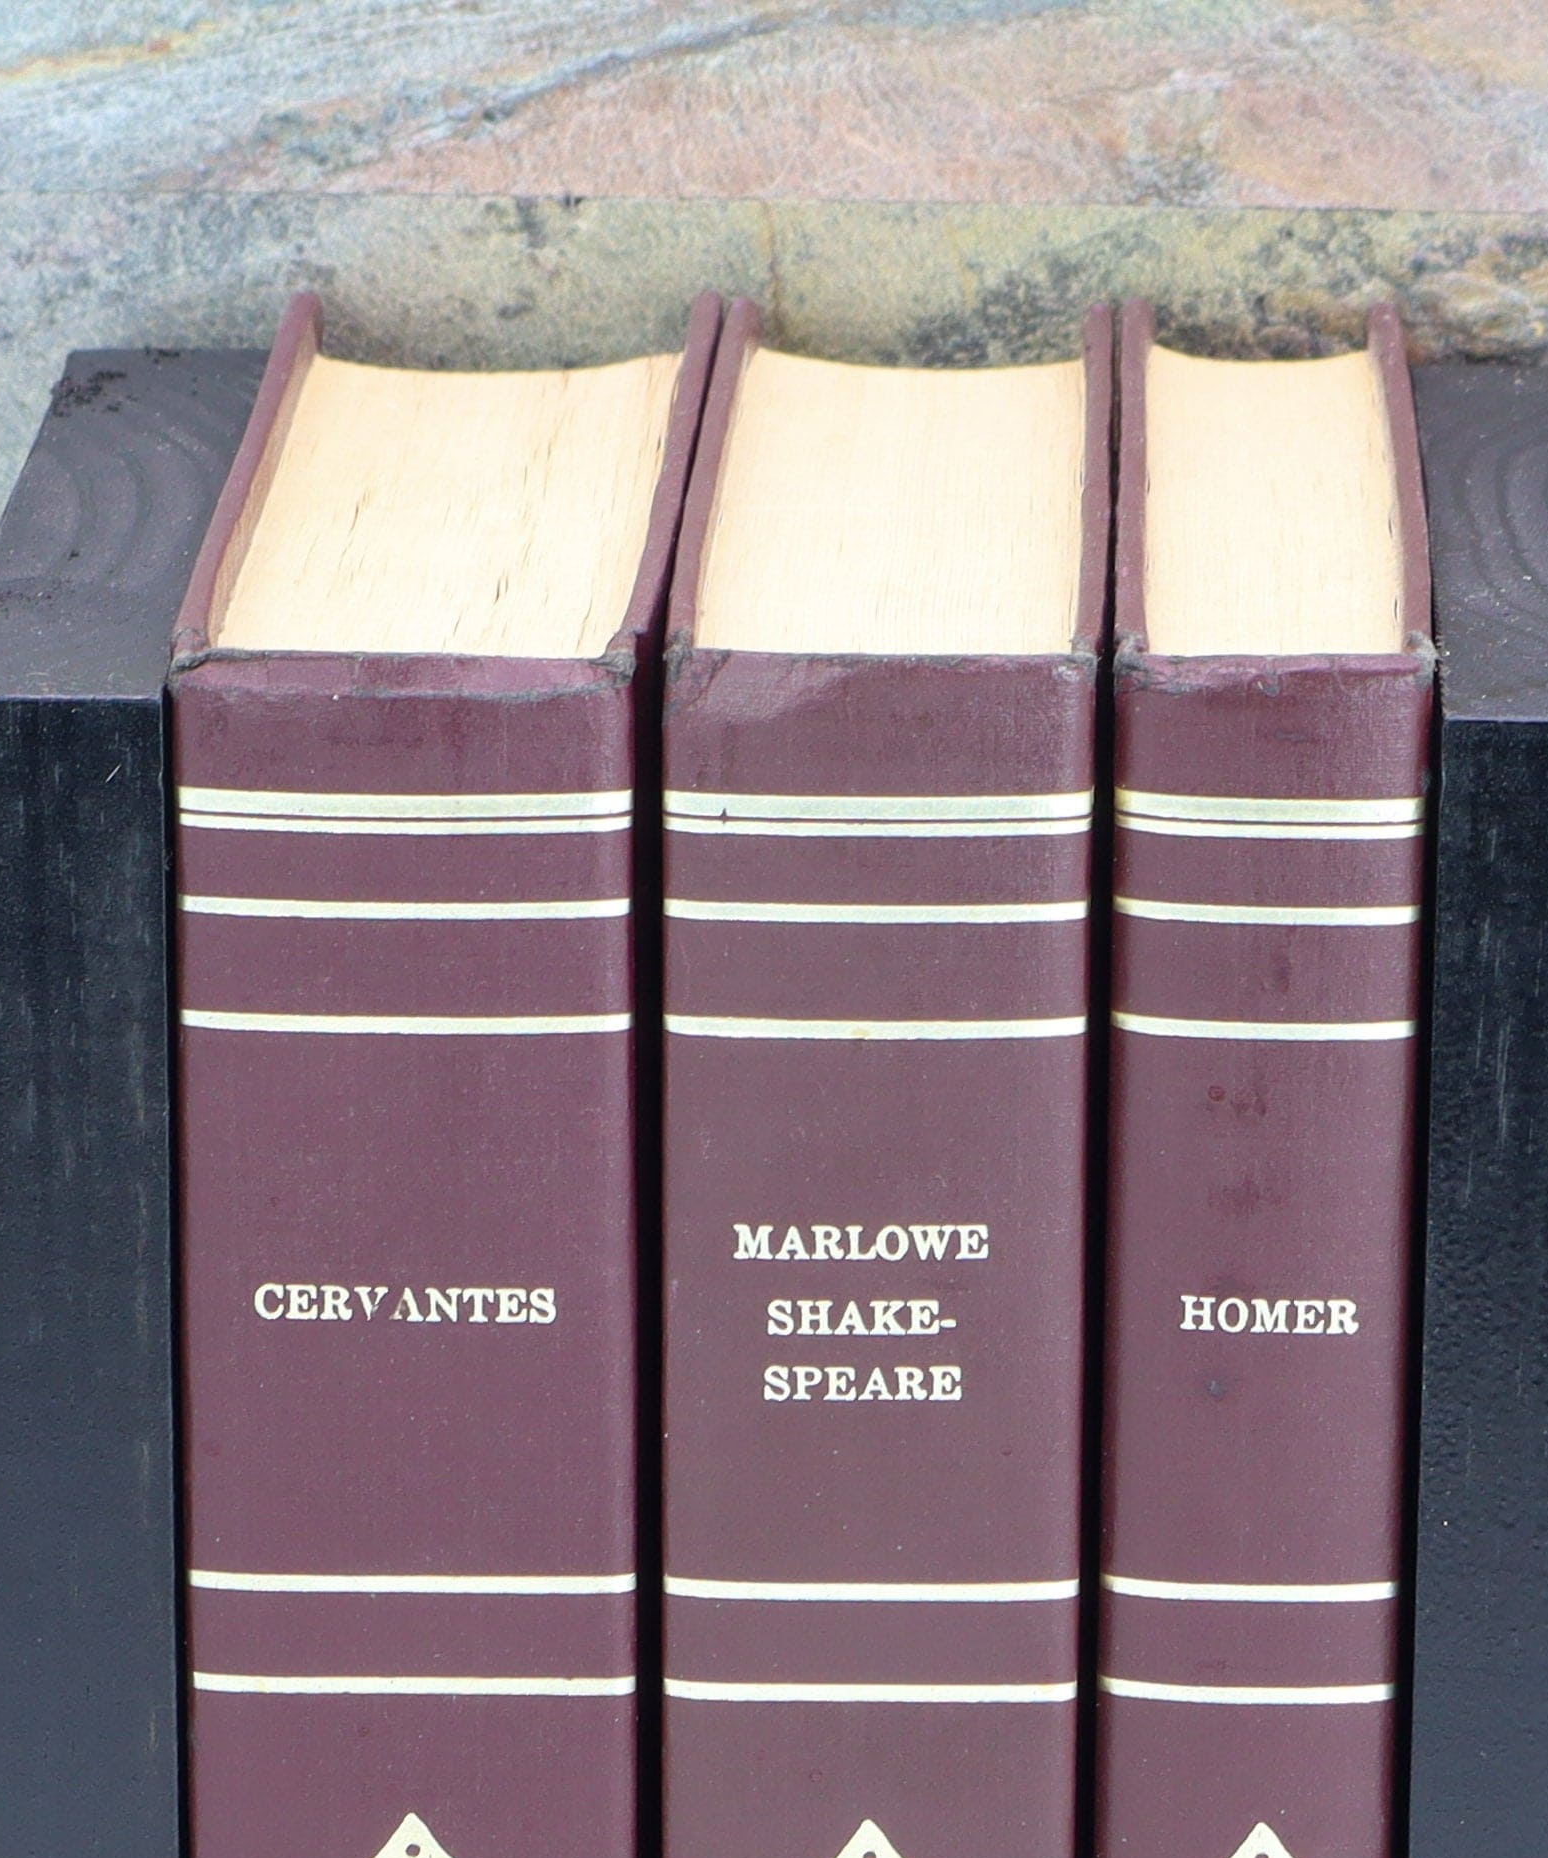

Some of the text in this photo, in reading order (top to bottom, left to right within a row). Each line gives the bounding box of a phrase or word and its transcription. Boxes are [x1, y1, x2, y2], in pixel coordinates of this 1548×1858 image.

[732, 1222, 990, 1262] MARLOWE
[253, 1282, 557, 1325] CERVANTES
[766, 1298, 957, 1337] SHAKE-
[1179, 1293, 1361, 1339] HOMER
[763, 1363, 963, 1402] SPEARE
